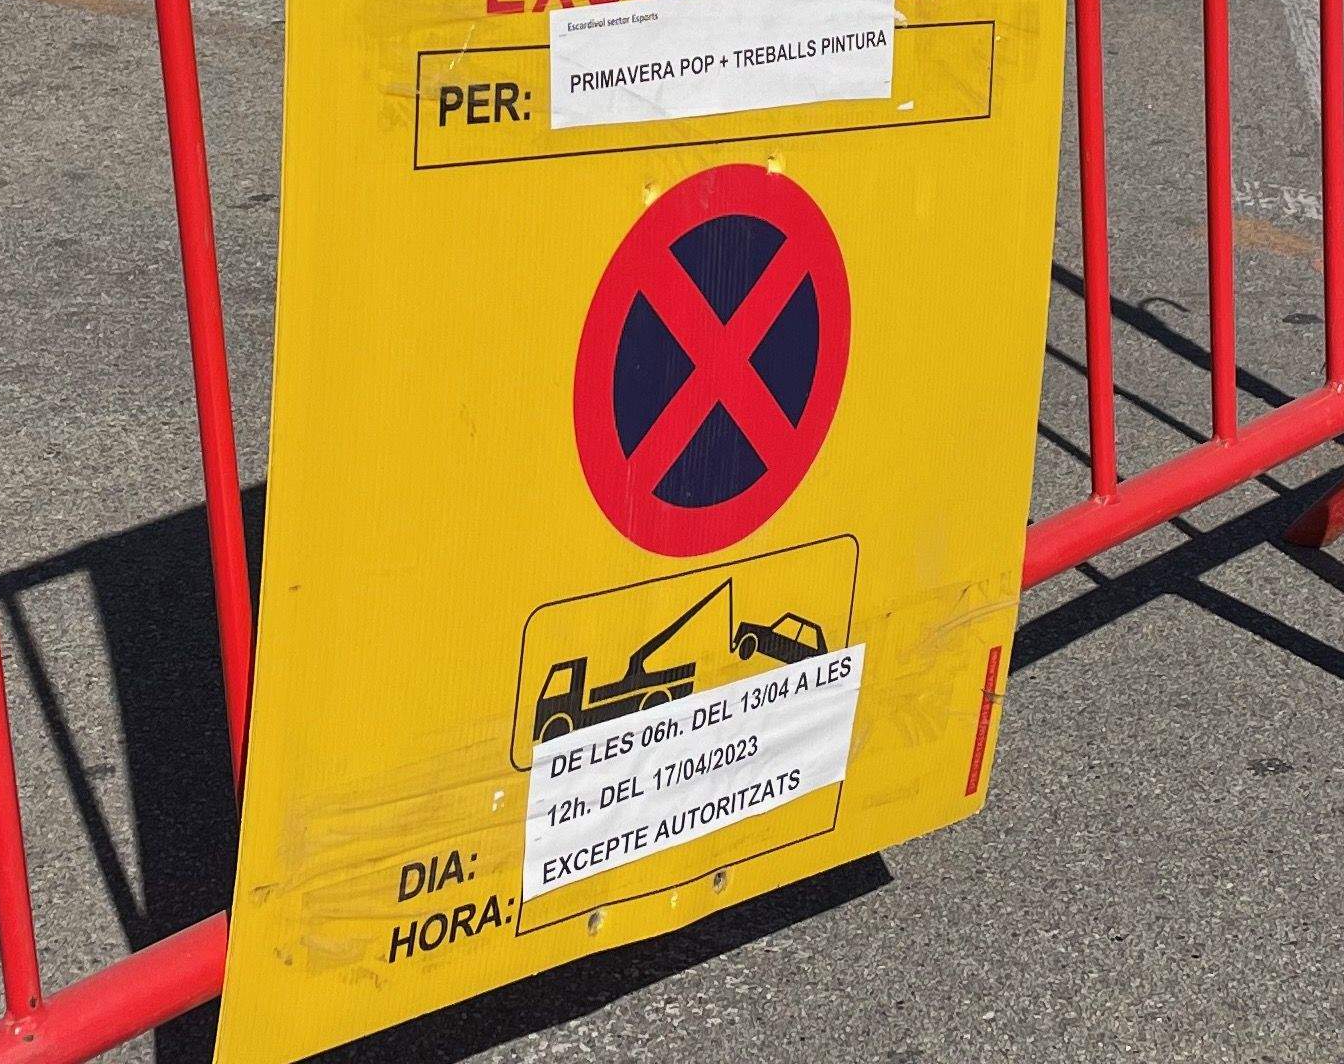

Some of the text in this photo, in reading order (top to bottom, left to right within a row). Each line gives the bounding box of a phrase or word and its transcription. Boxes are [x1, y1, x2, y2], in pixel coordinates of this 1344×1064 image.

[569, 29, 887, 93] PRIMAVERA POP + TREBALLS PINTURA
[438, 81, 533, 127] PER:
[550, 656, 852, 779] DE LES 06h. DEL 13/04 A LES
[547, 735, 759, 827] 12h. DEL 17/04/2023
[542, 768, 801, 885] EXCEPTE AUTORITZATS
[398, 849, 478, 903] DIA:
[388, 894, 515, 964] HORA:
